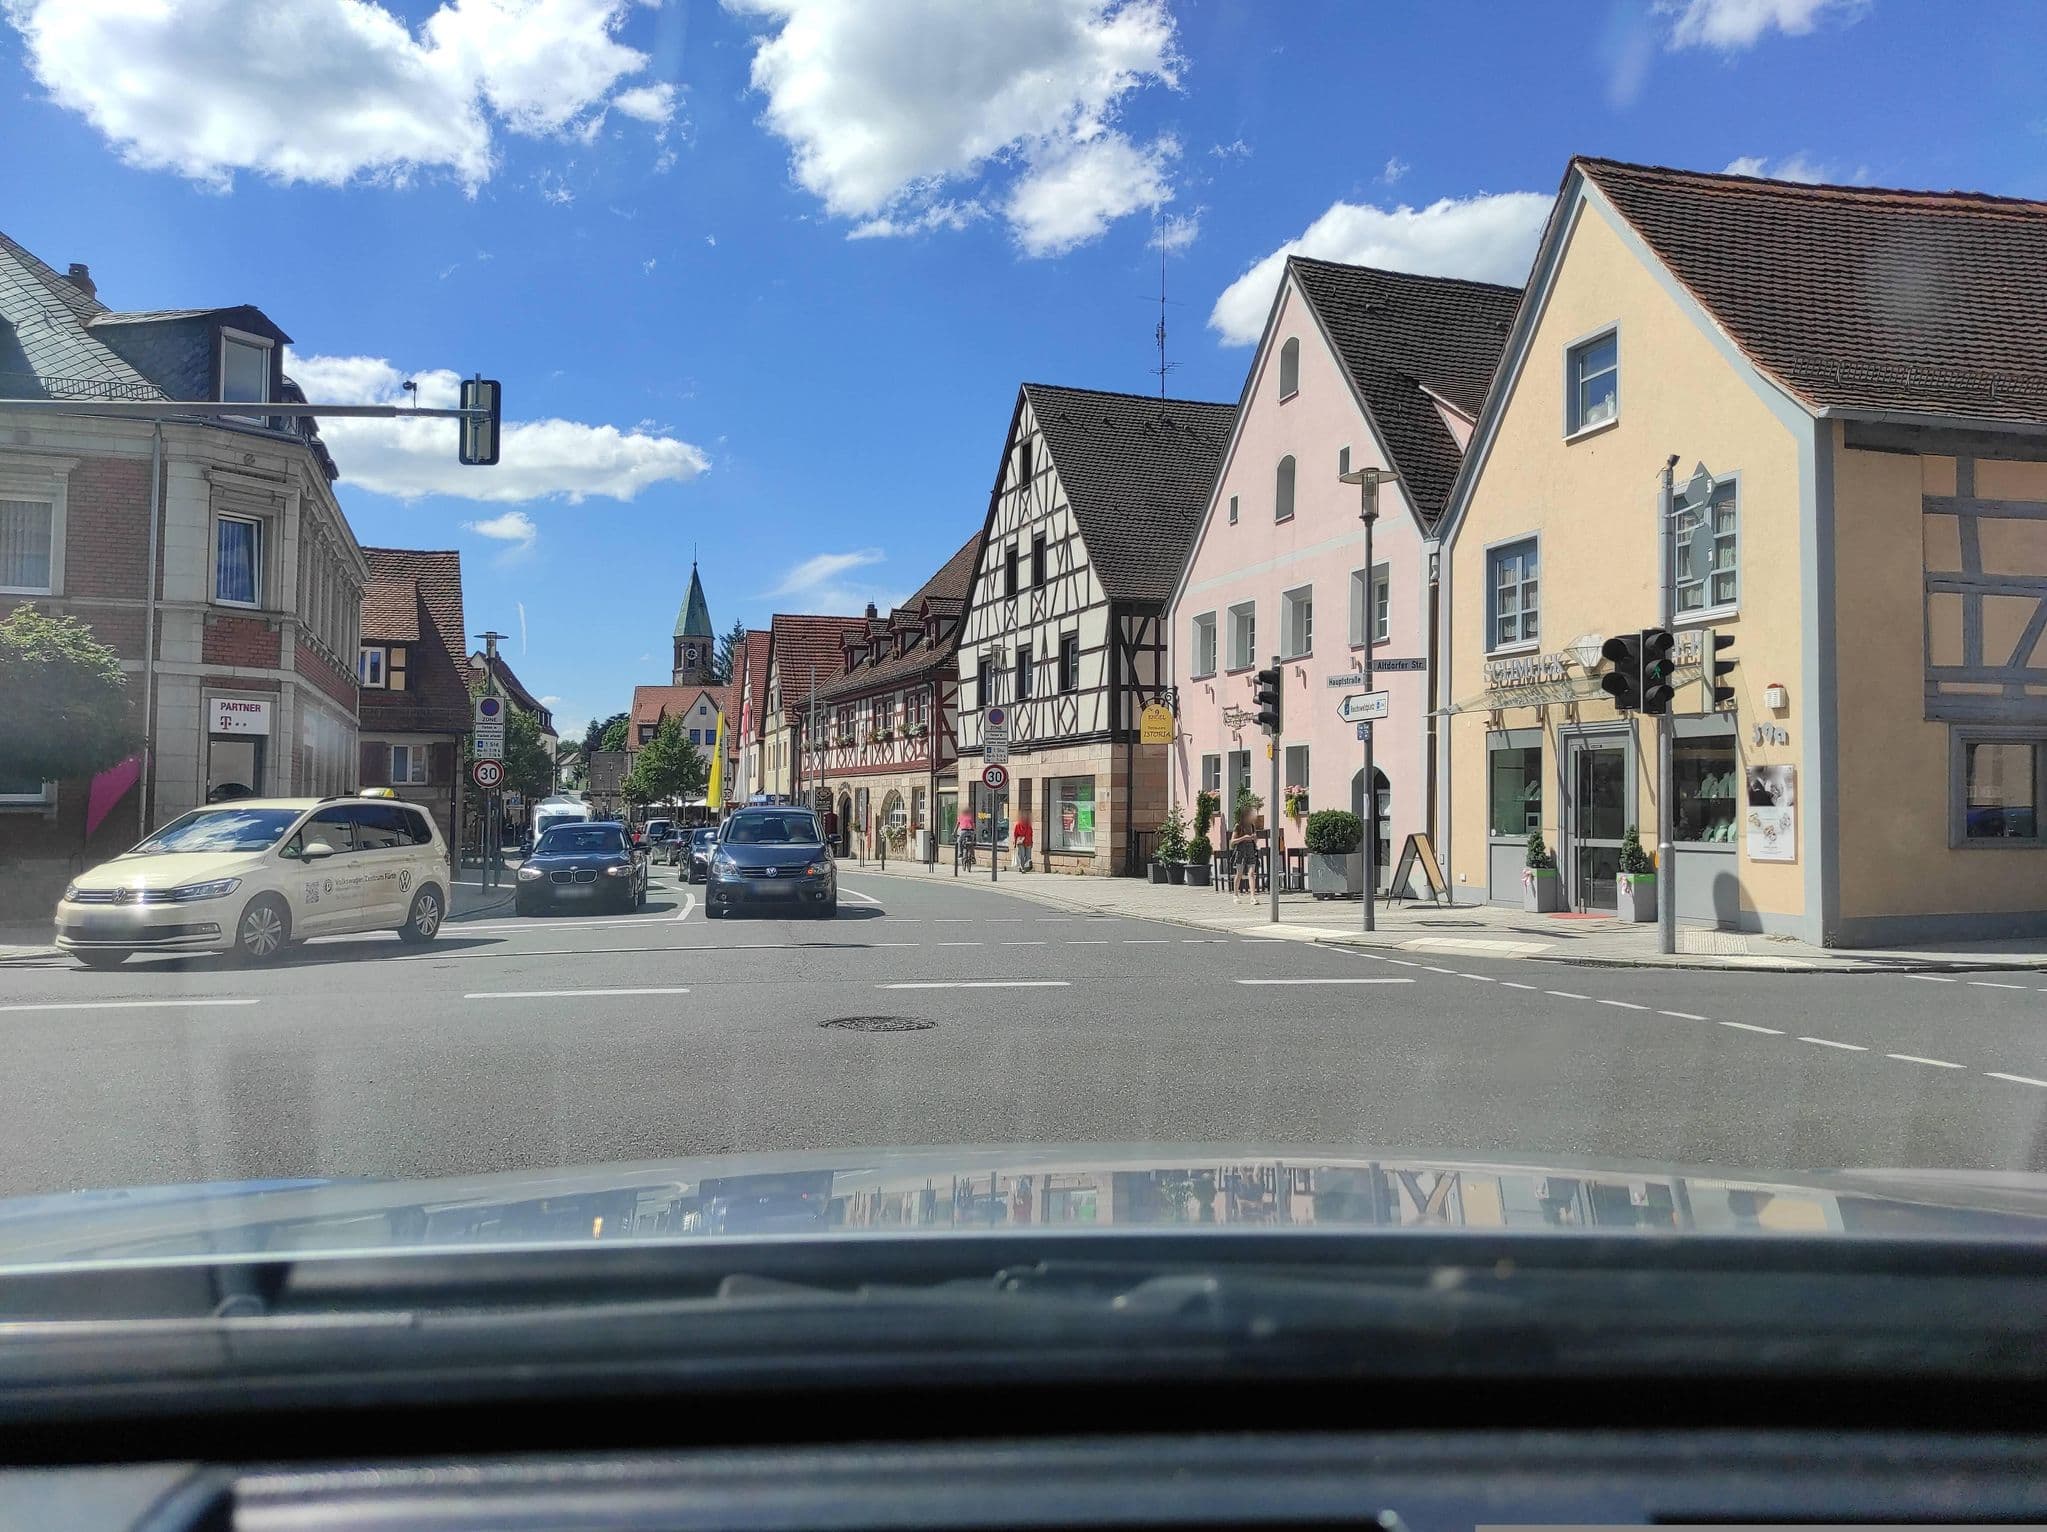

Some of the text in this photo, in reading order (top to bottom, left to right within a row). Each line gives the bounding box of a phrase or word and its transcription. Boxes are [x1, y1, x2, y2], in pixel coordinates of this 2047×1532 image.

[1377, 660, 1424, 670] Altdorfer Str.
[1483, 652, 1566, 683] SCHMUCK
[1328, 675, 1361, 688] Hauptstraße
[220, 702, 261, 712] PARTNER
[480, 768, 497, 780] 30
[987, 771, 1002, 783] 30
